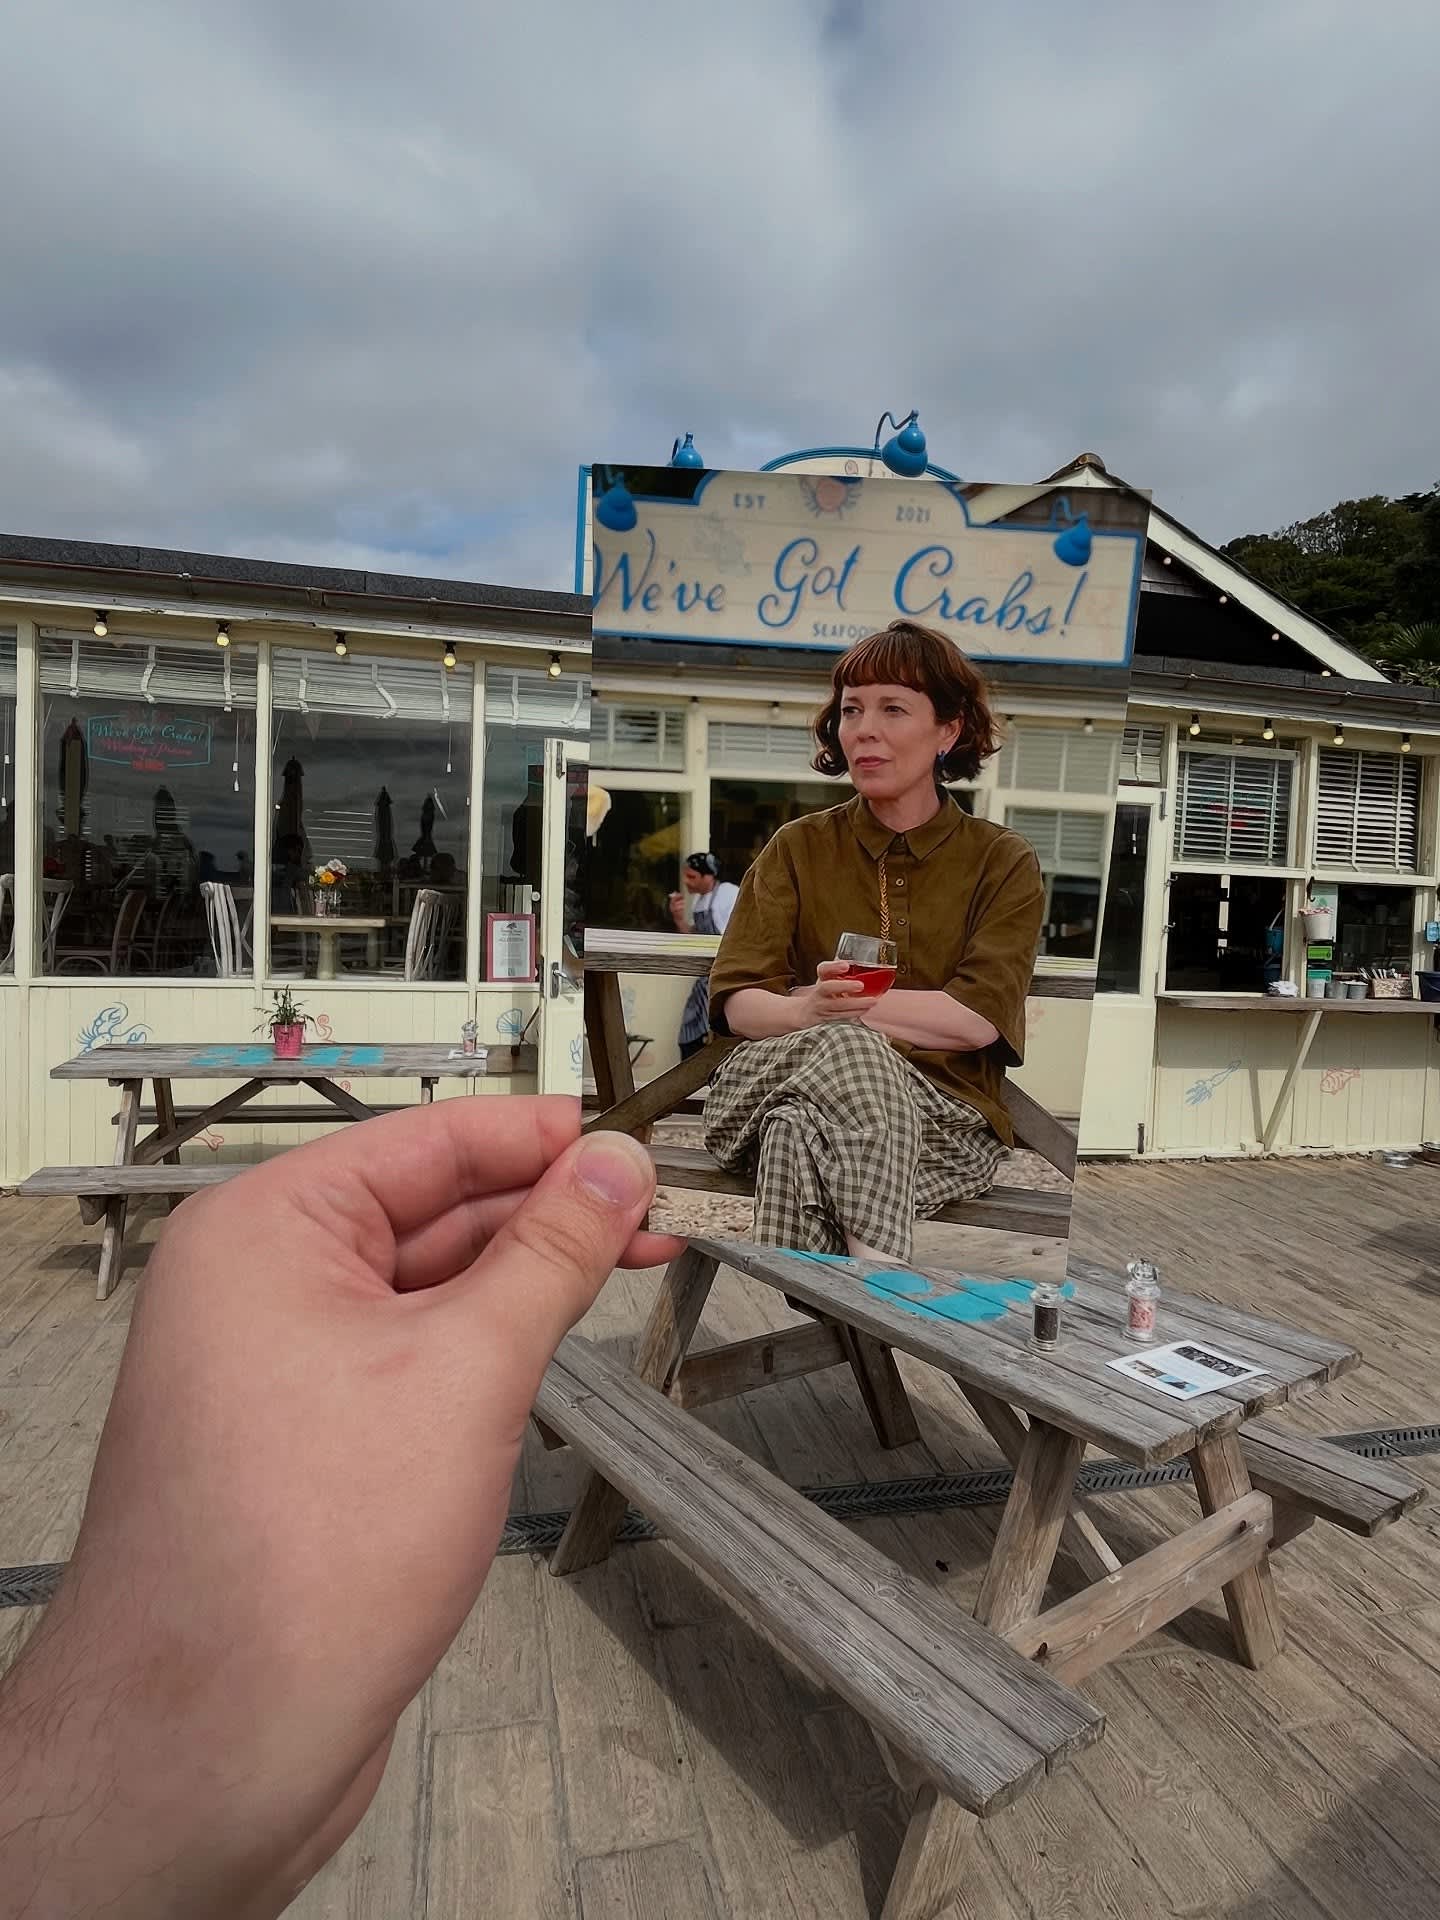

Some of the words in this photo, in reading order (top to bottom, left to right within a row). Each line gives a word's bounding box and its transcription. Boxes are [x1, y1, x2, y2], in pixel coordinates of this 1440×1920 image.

[733, 492, 767, 509] EST
[895, 504, 931, 523] 2021
[592, 528, 727, 614] We've
[758, 537, 861, 628] Got
[893, 544, 1088, 636] Crabs!
